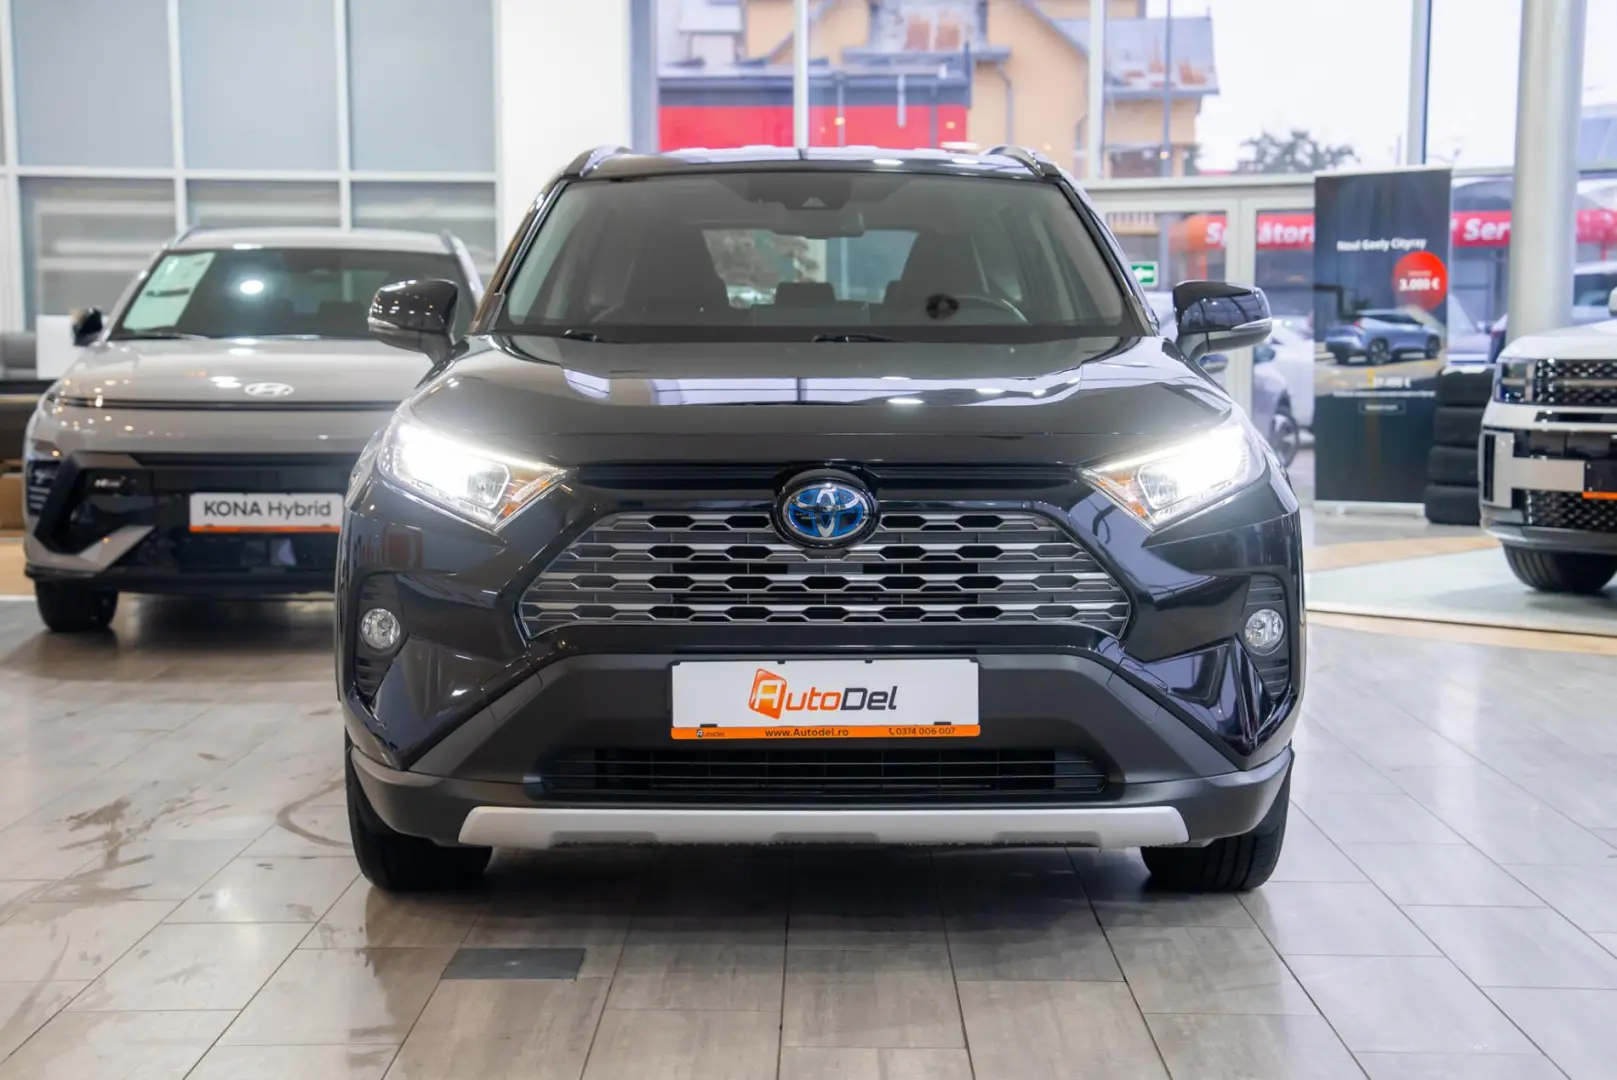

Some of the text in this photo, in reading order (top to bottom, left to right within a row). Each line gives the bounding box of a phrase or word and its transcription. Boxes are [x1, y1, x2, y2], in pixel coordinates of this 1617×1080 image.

[203, 501, 331, 520] KONA Hybrid
[751, 672, 898, 714] AutoDel
[764, 727, 850, 738] www.Autodel.ro
[896, 726, 956, 736] 0374 006 007
